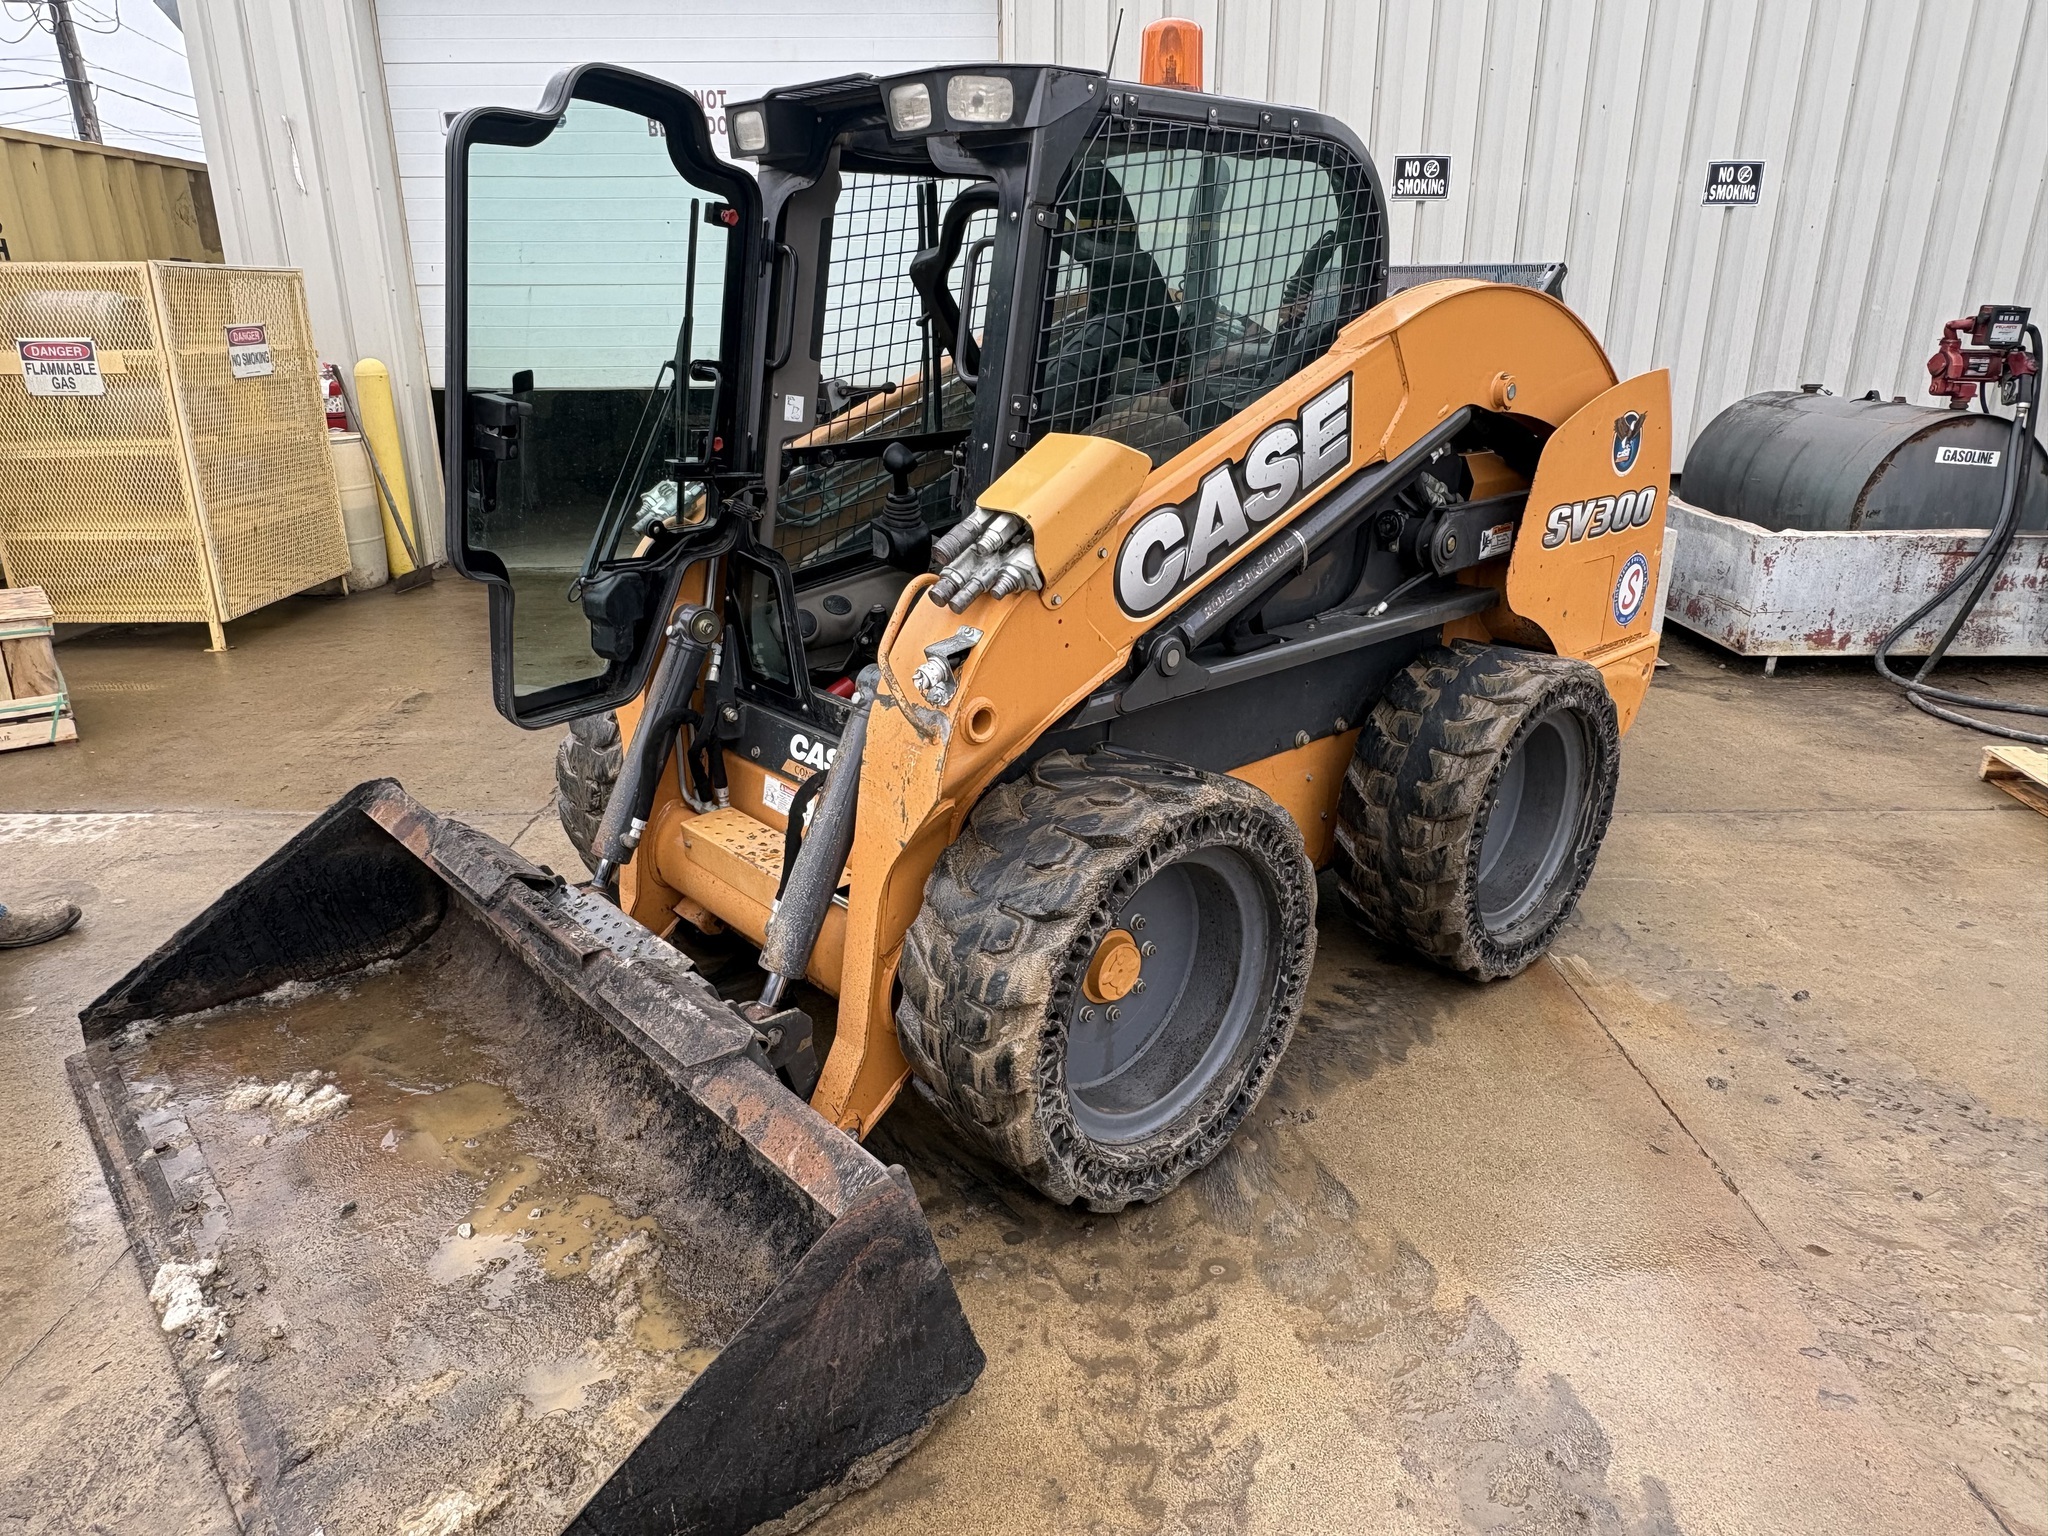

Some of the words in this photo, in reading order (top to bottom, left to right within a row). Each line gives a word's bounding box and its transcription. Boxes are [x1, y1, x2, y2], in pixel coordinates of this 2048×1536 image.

[705, 115, 727, 135] DO
[1404, 160, 1421, 178] NO
[1717, 166, 1735, 183] NO
[1396, 178, 1445, 195] SMOKING
[1708, 184, 1756, 201] SMOKING
[232, 330, 261, 342] DANGER
[30, 345, 83, 357] DANGER
[241, 350, 270, 366] SMOKING
[231, 353, 242, 367] NO
[24, 362, 97, 376] FLAMMABLE
[51, 376, 77, 390] GAS
[1942, 449, 1995, 465] GASOLINE
[1117, 375, 1350, 613] CASE
[1542, 484, 1657, 548] SV300
[790, 733, 837, 771] CAS
